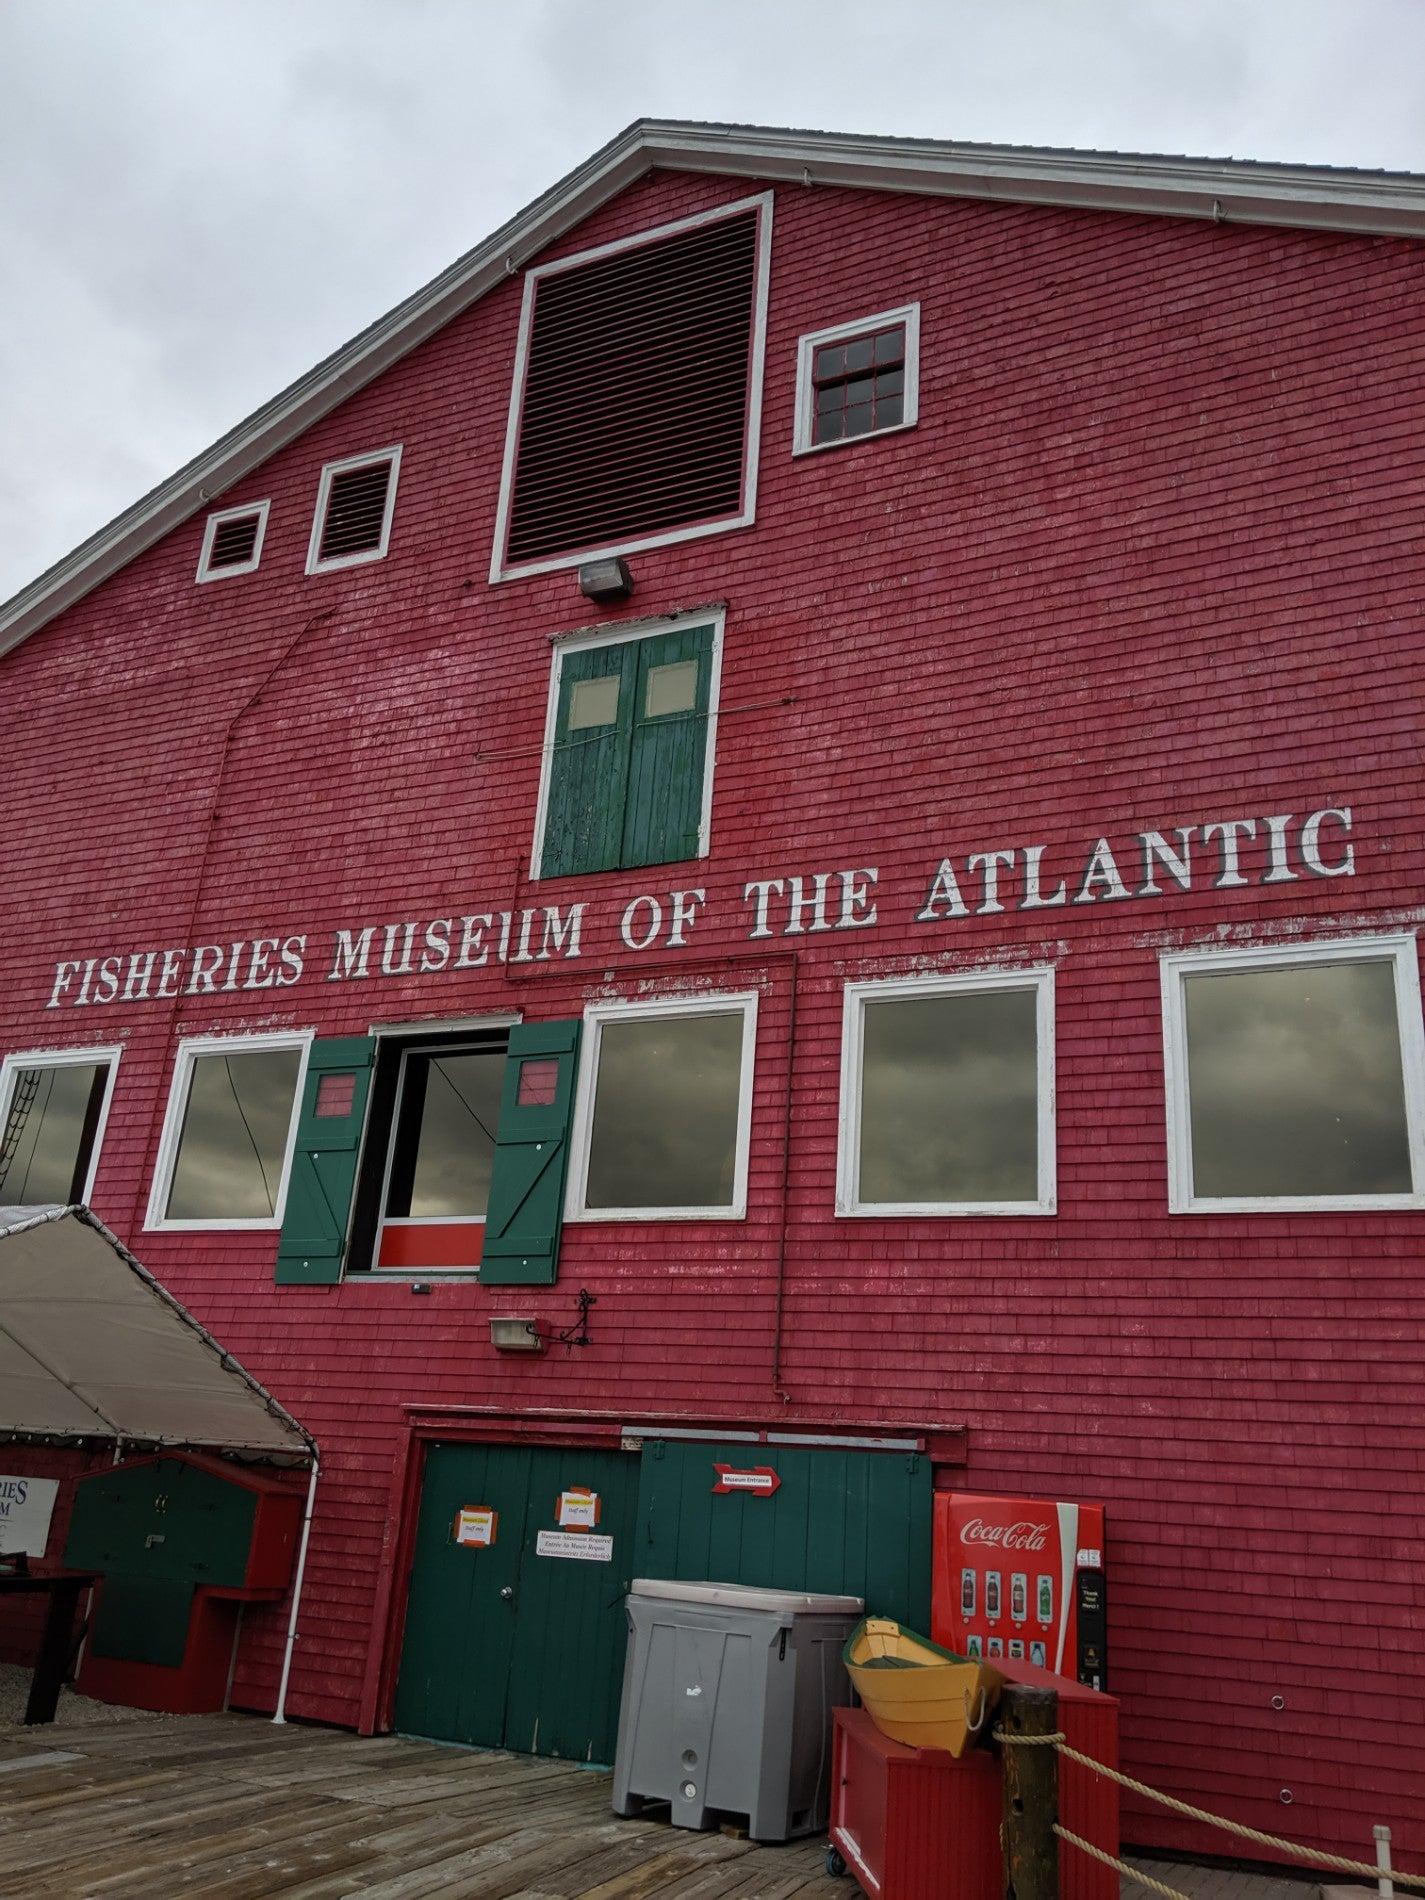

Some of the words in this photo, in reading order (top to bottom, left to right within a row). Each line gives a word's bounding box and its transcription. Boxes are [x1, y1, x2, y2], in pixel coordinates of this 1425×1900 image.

[46, 934, 307, 1009] FISHERIES
[328, 902, 590, 980] MUSEUM
[620, 887, 706, 950] OF
[744, 867, 879, 940] THE
[916, 807, 1357, 922] ATLANTIC
